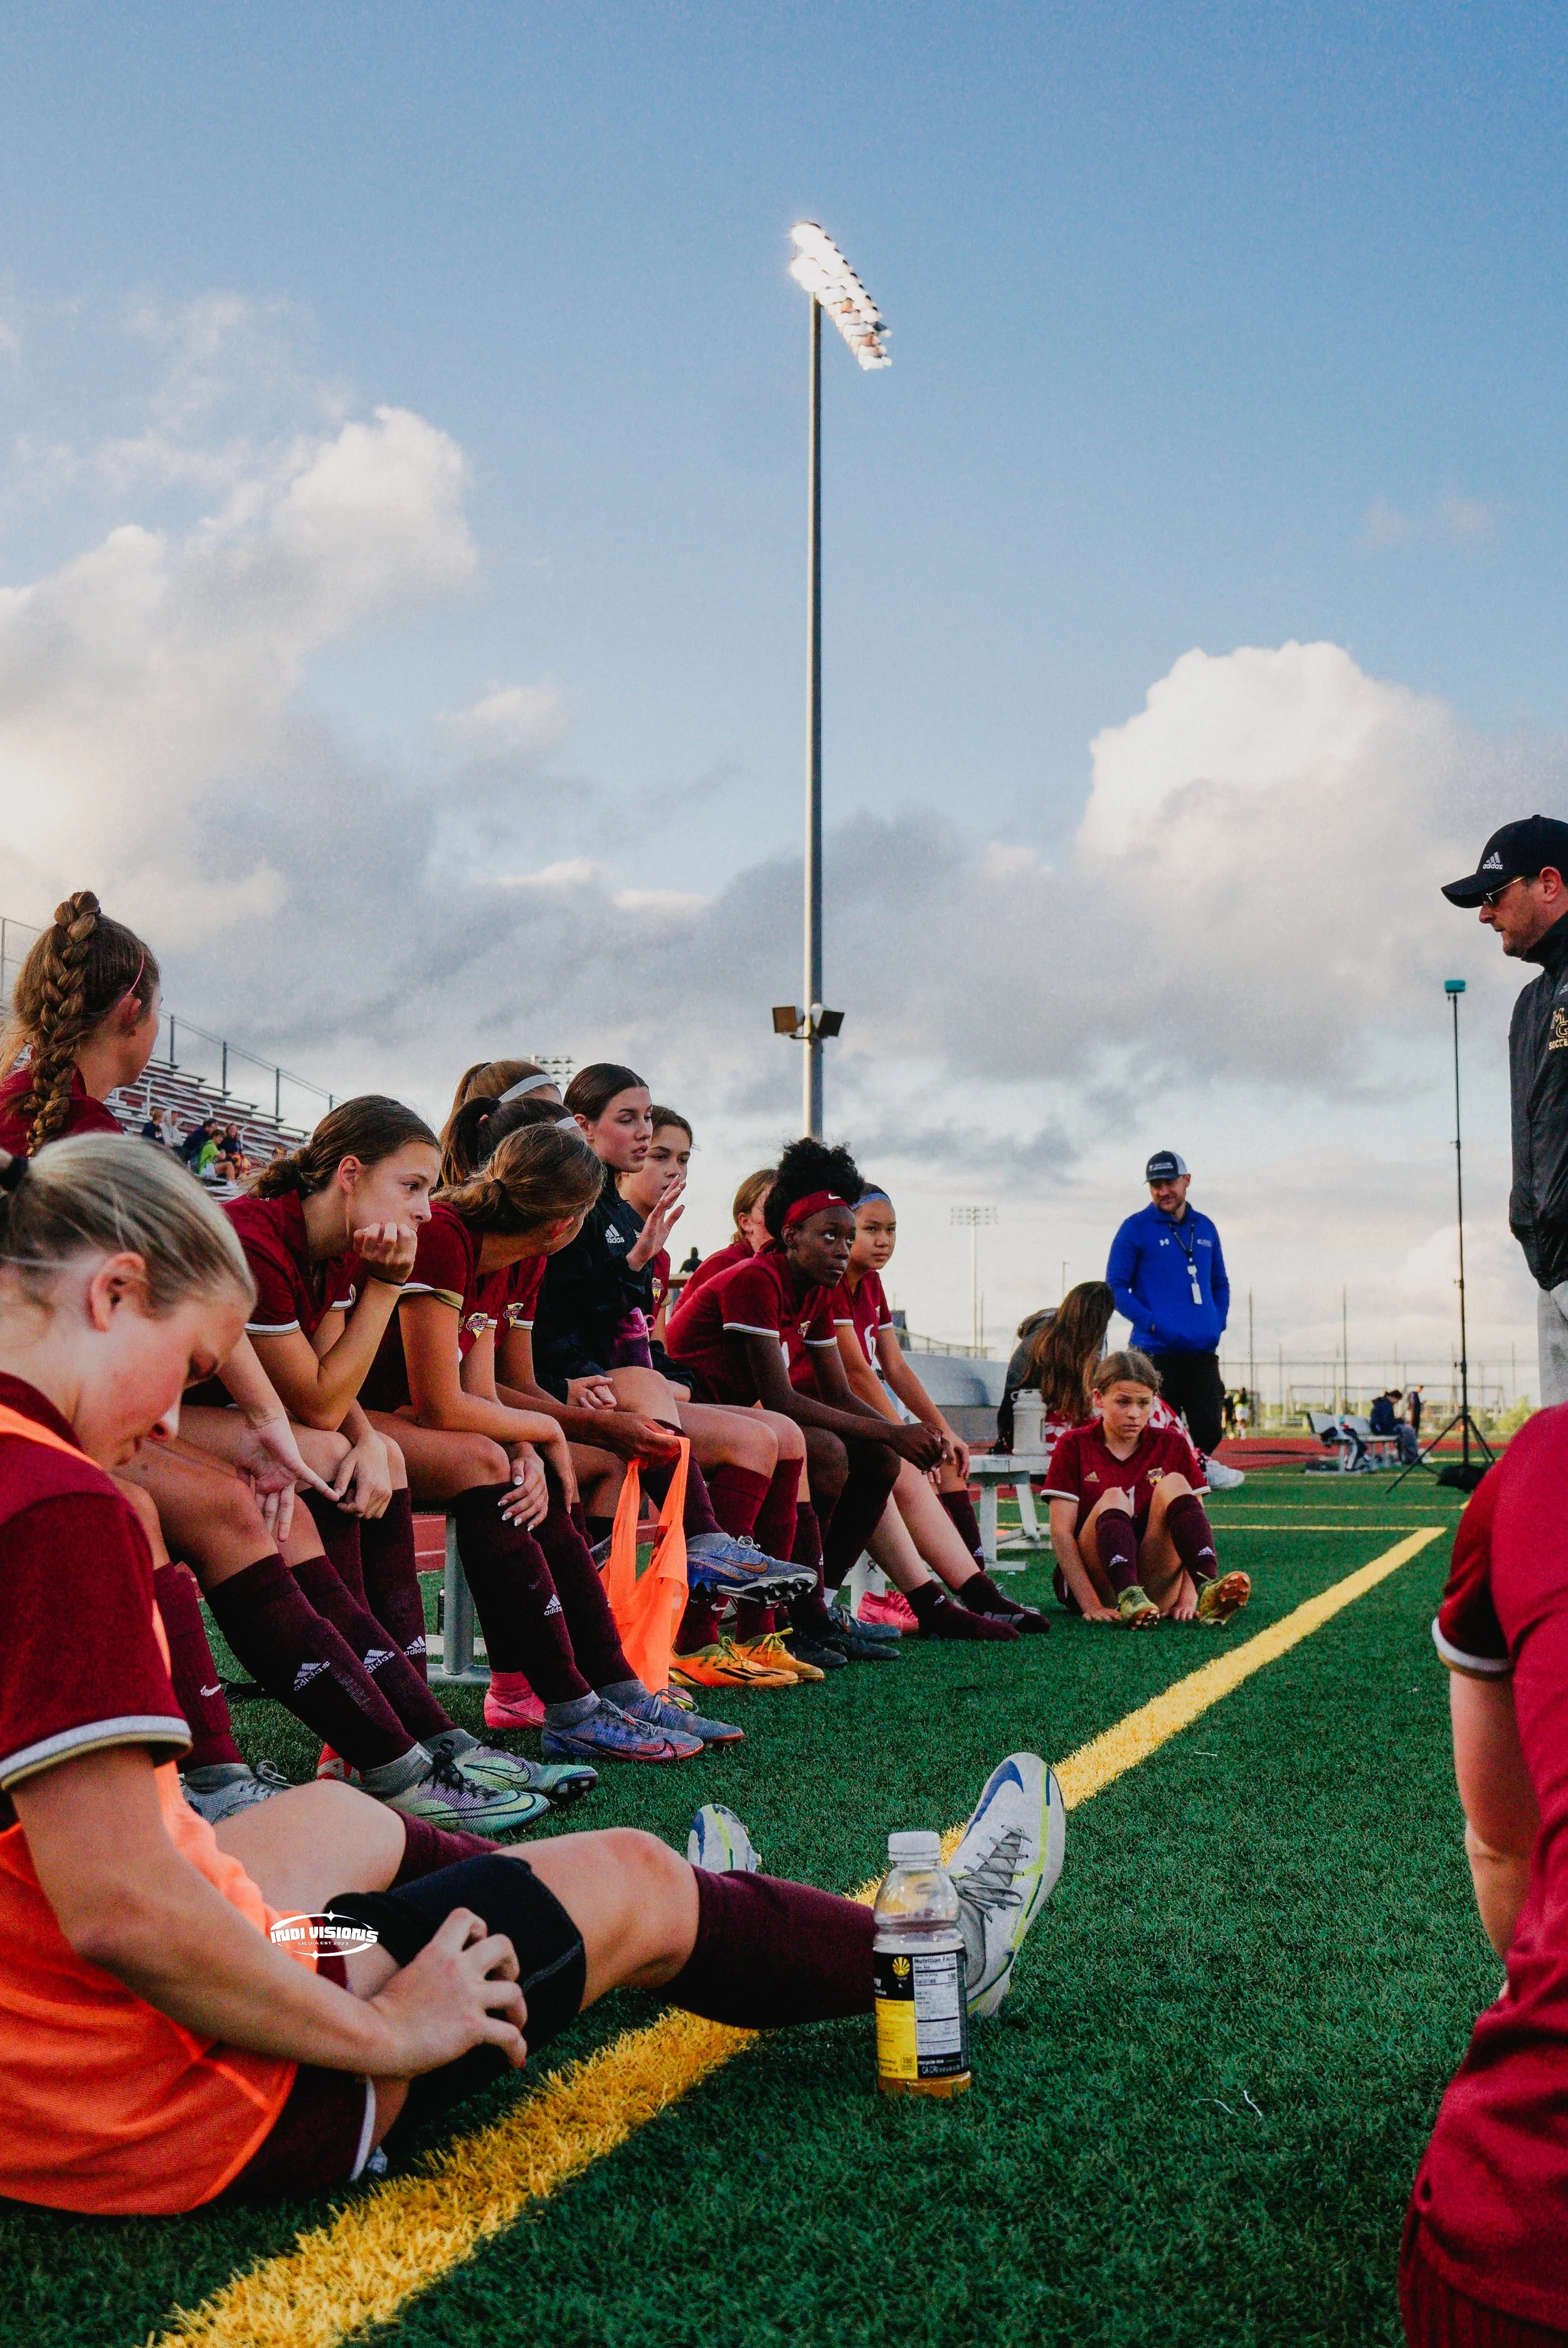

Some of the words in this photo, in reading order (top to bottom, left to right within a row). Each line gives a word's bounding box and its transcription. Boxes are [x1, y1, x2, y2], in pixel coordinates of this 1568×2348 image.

[1549, 1038, 1568, 1050] SOCCE
[864, 1323, 876, 1361] 6
[544, 1605, 563, 1616] adida
[403, 1646, 426, 1656] adida
[366, 1651, 396, 1674] didas
[294, 1661, 331, 1691] adidas
